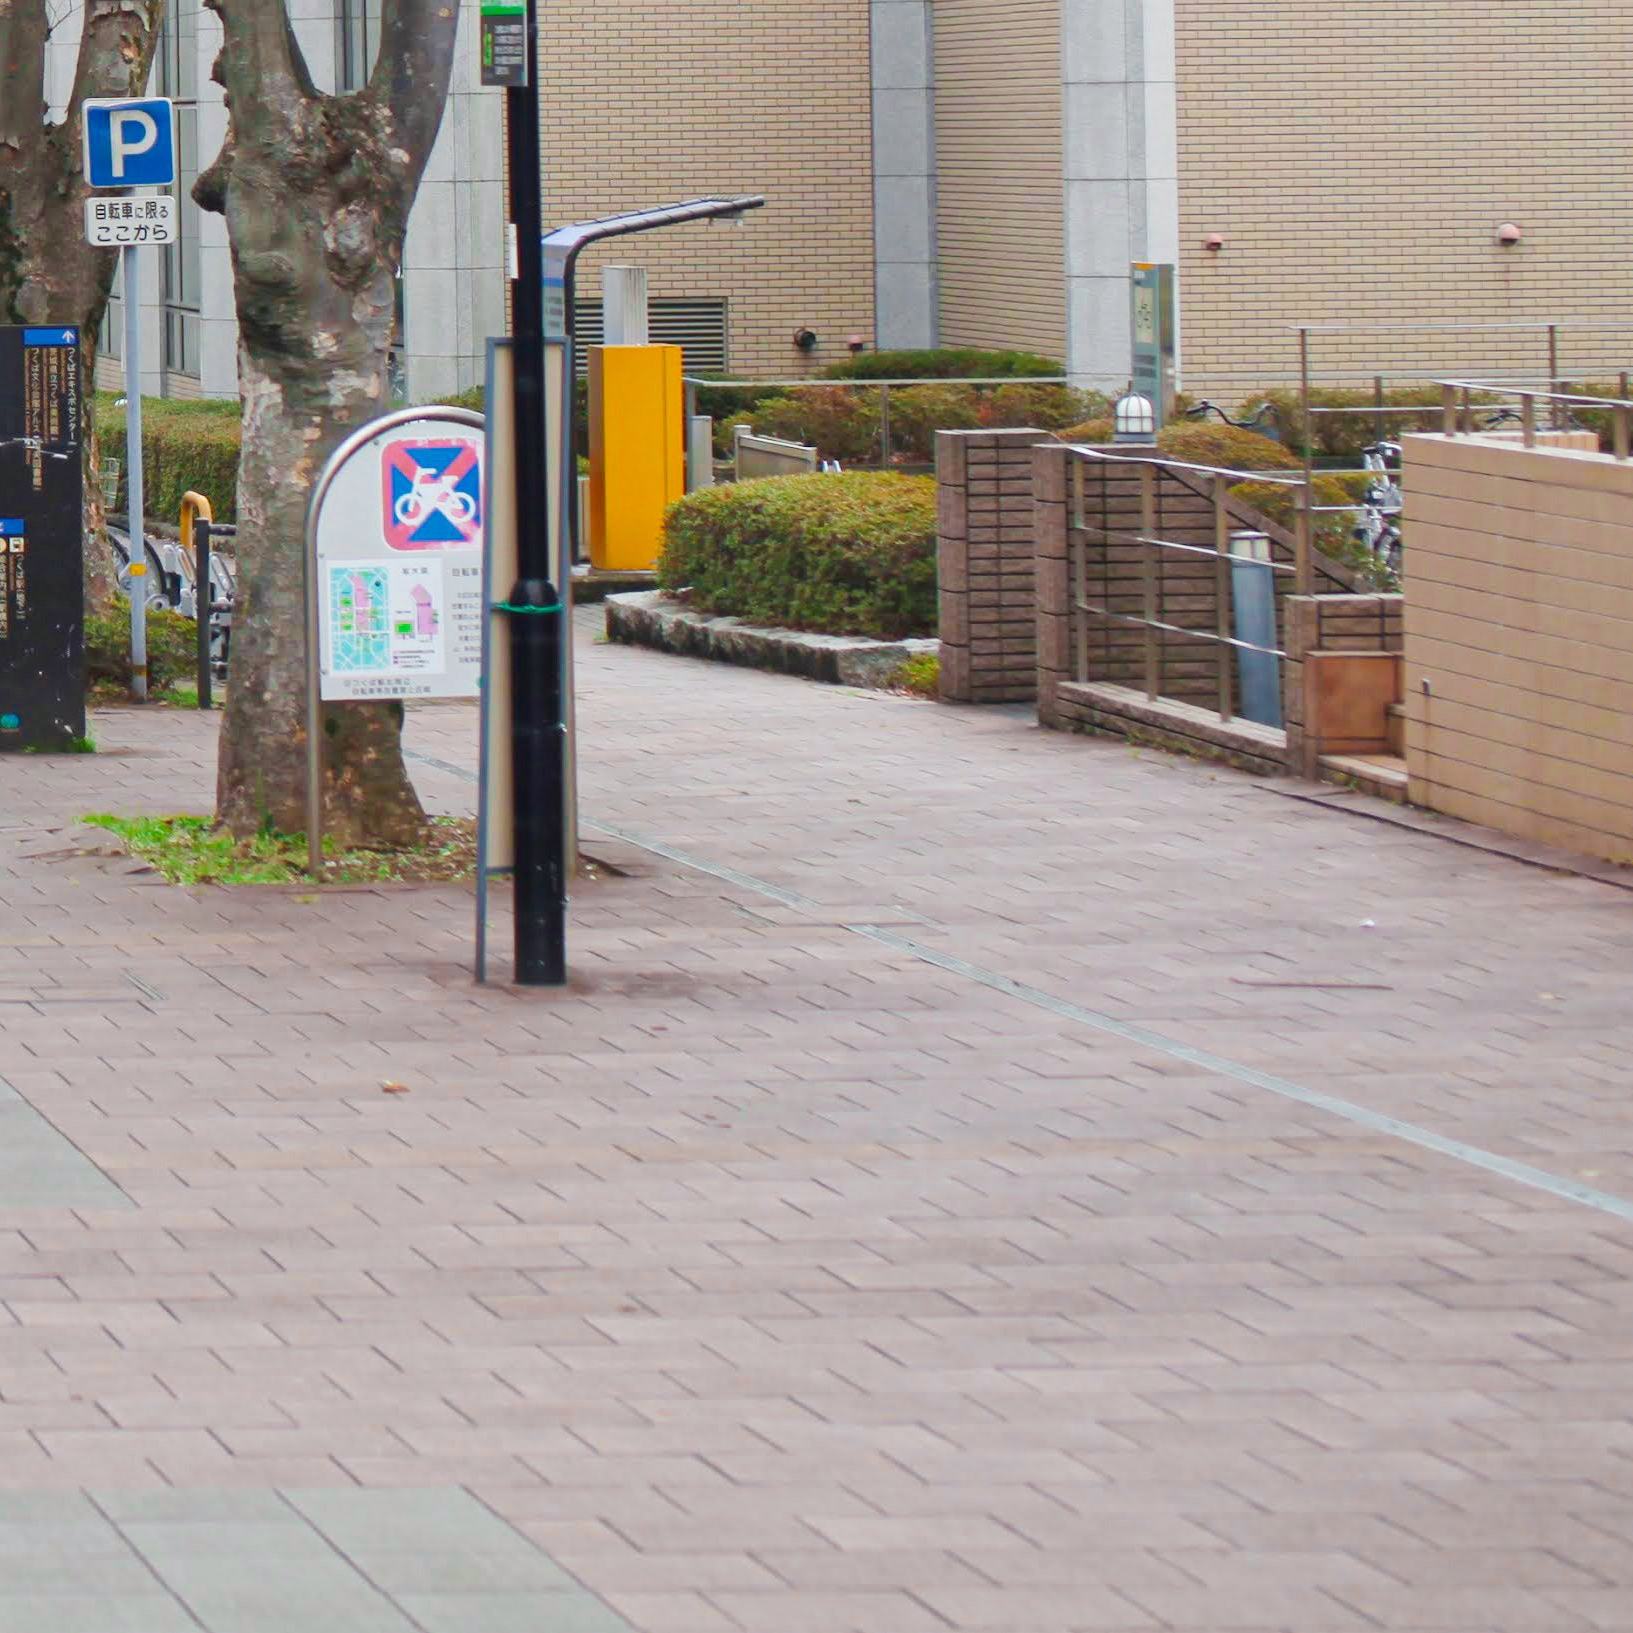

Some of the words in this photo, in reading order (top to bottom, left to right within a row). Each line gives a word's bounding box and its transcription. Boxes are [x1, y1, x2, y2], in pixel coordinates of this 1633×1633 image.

[109, 109, 158, 177] P
[95, 201, 169, 220] 自転車に限る
[97, 223, 168, 242] ここから
